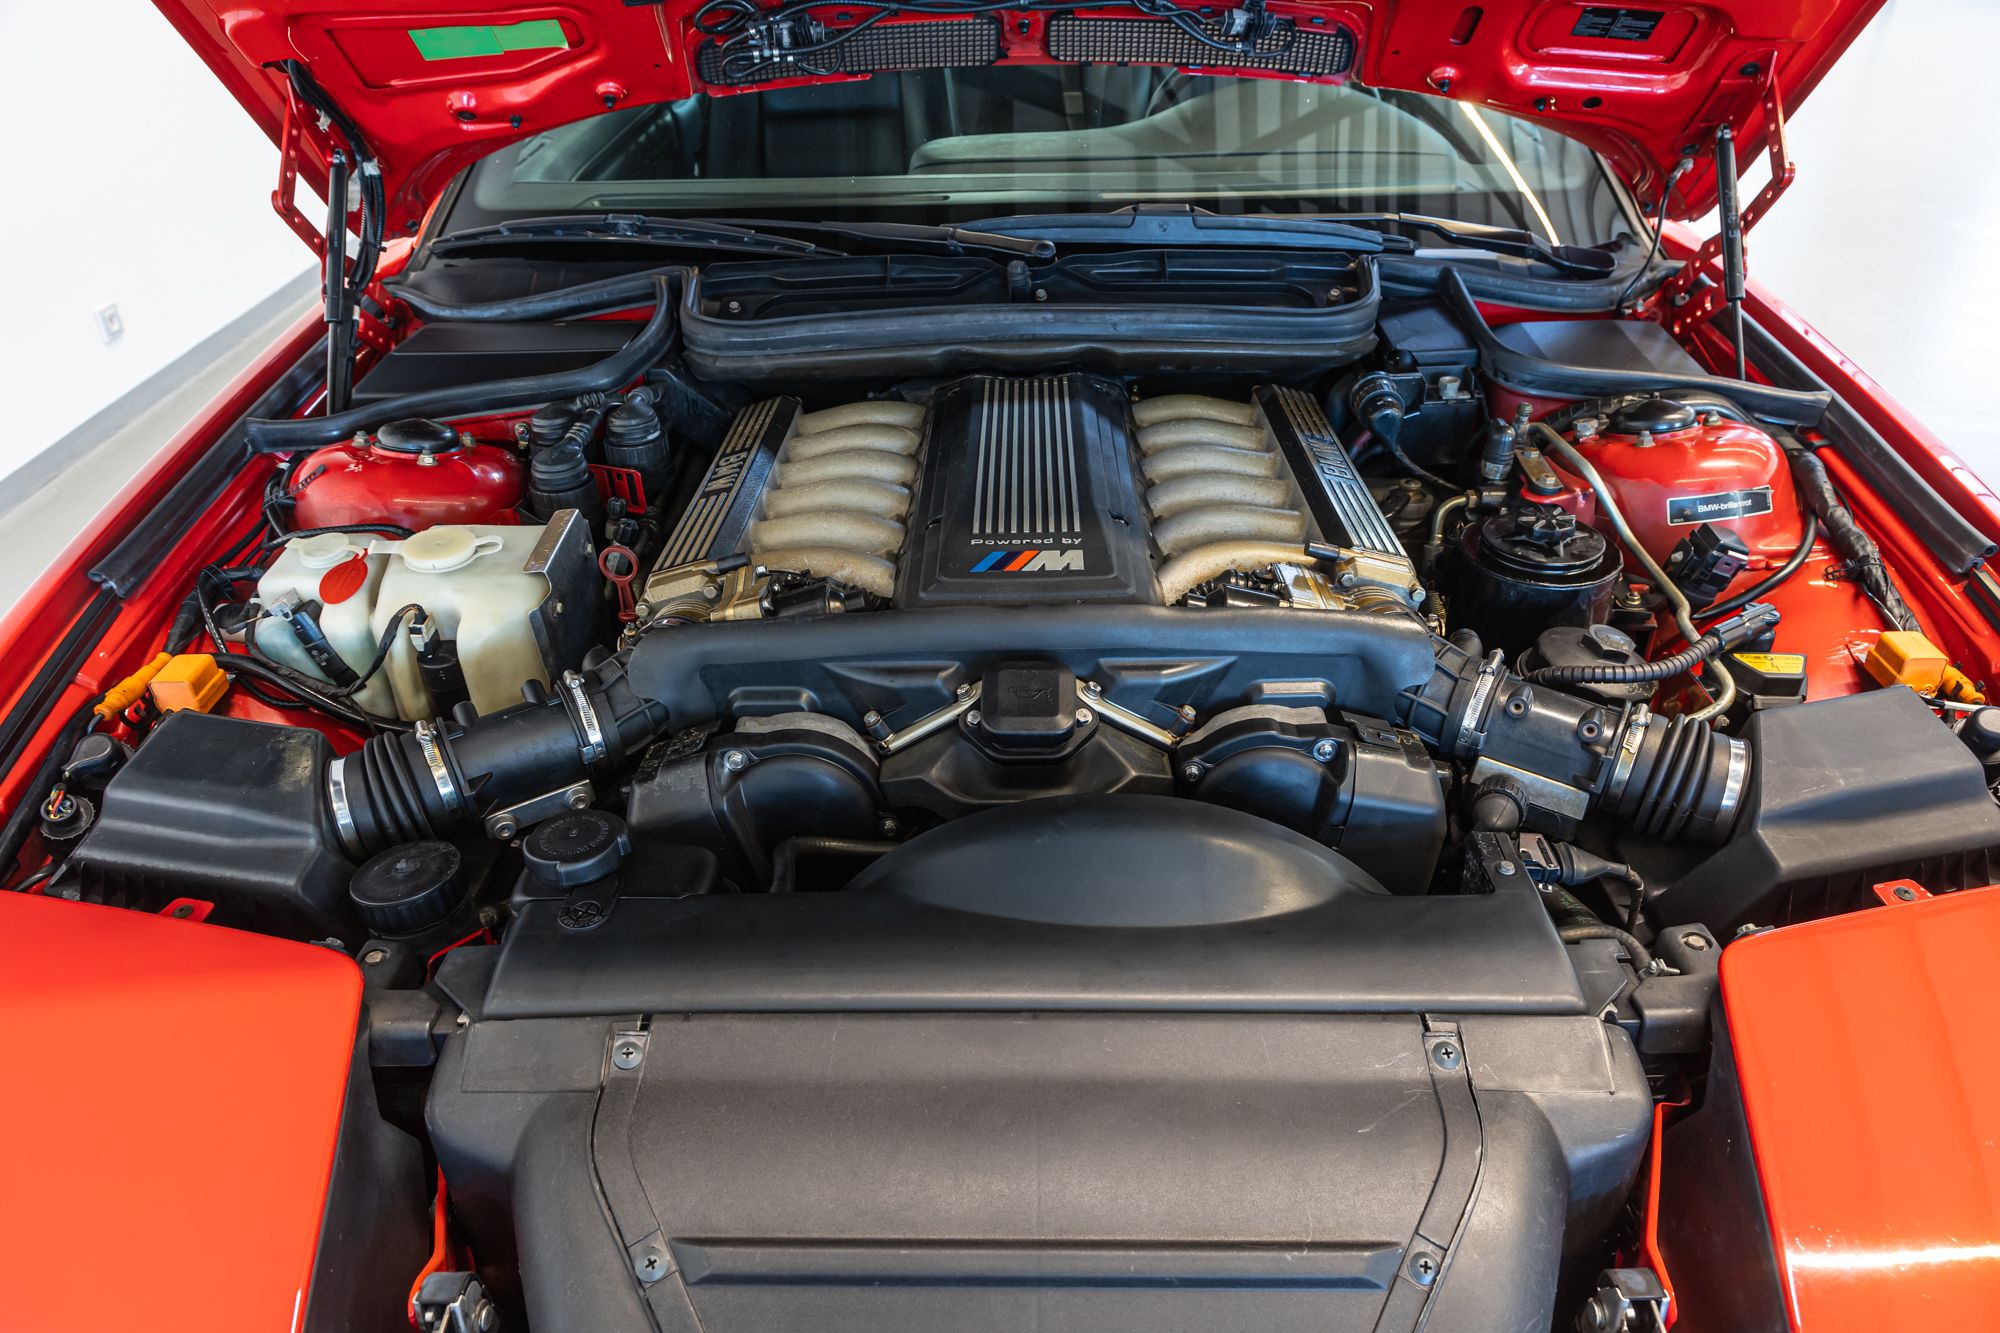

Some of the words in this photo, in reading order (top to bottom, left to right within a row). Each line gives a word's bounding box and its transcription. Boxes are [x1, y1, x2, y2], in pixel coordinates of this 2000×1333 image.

[704, 451, 748, 492] BMW
[1307, 439, 1354, 480] BMW
[970, 537, 1054, 546] Powered
[1061, 537, 1082, 545] by
[1020, 549, 1085, 572] M
